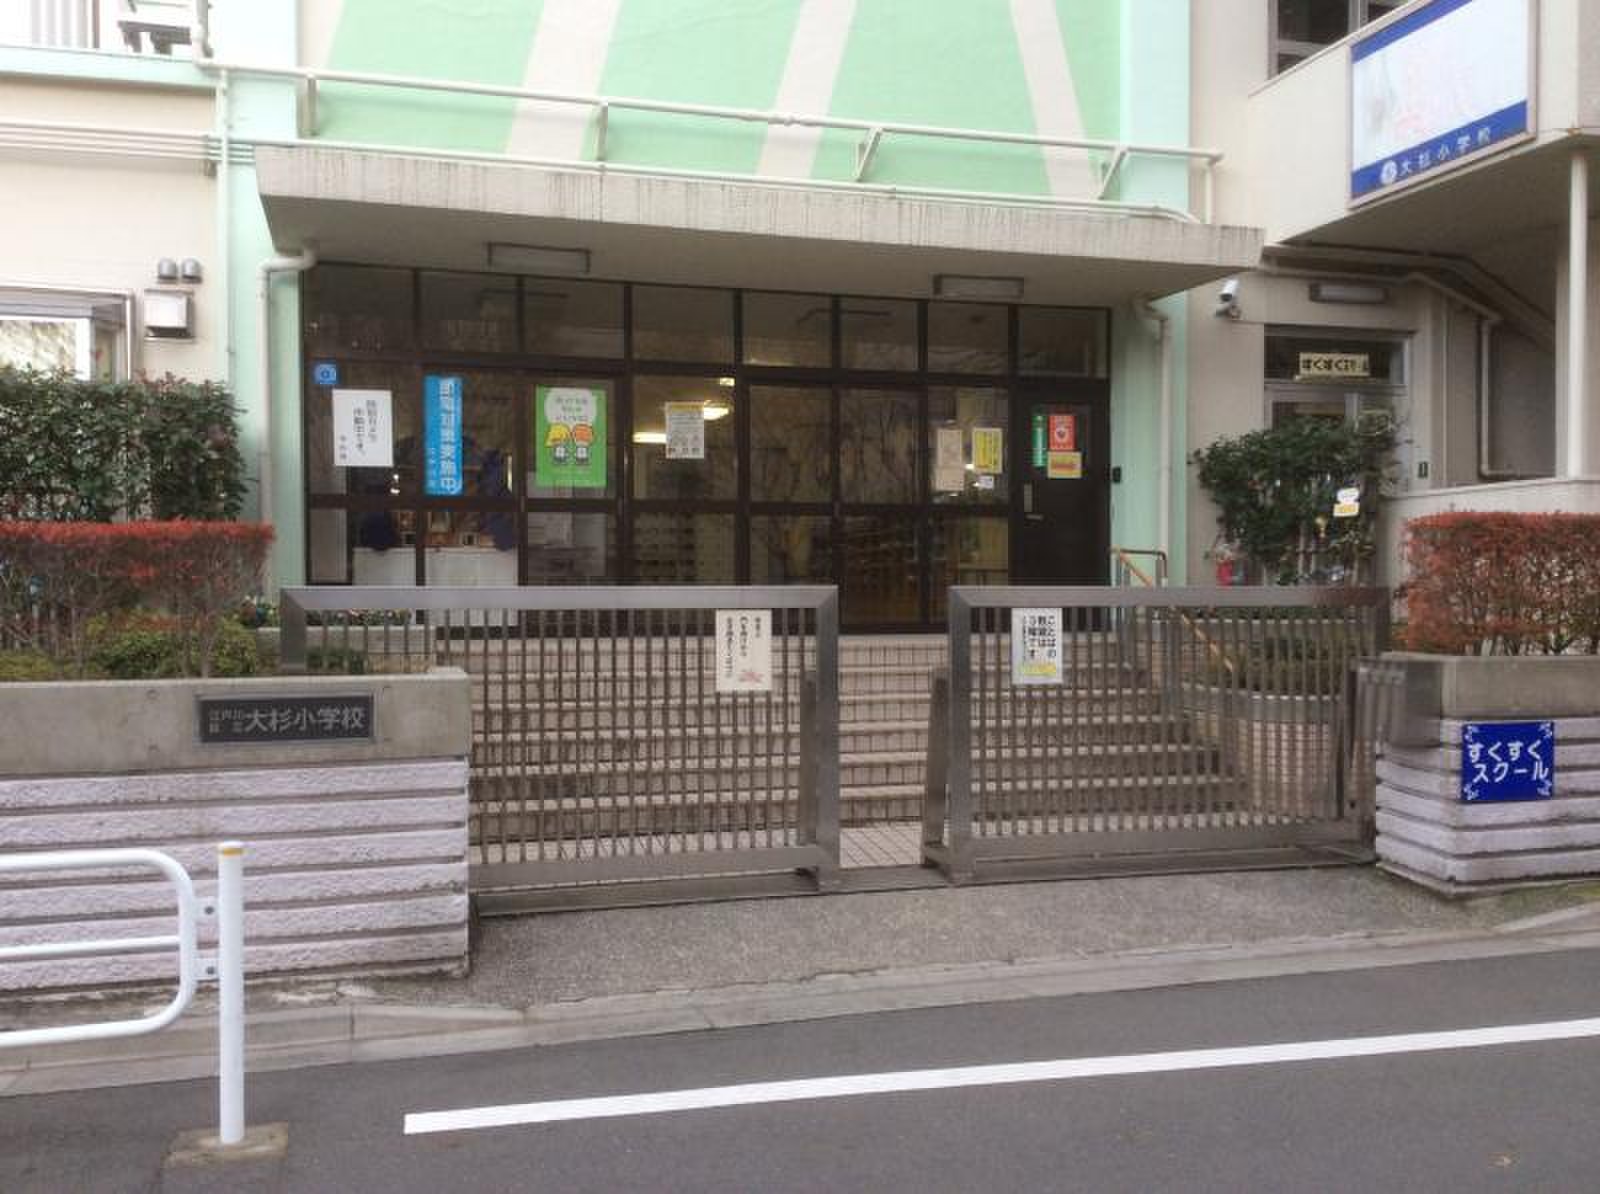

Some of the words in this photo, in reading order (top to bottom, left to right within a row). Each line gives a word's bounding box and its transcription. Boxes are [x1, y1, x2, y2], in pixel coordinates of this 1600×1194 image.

[1048, 615, 1057, 659] ことばの
[244, 706, 365, 733] 大杉小学校
[1467, 740, 1542, 763] すくすく
[1472, 760, 1550, 783] スクール
